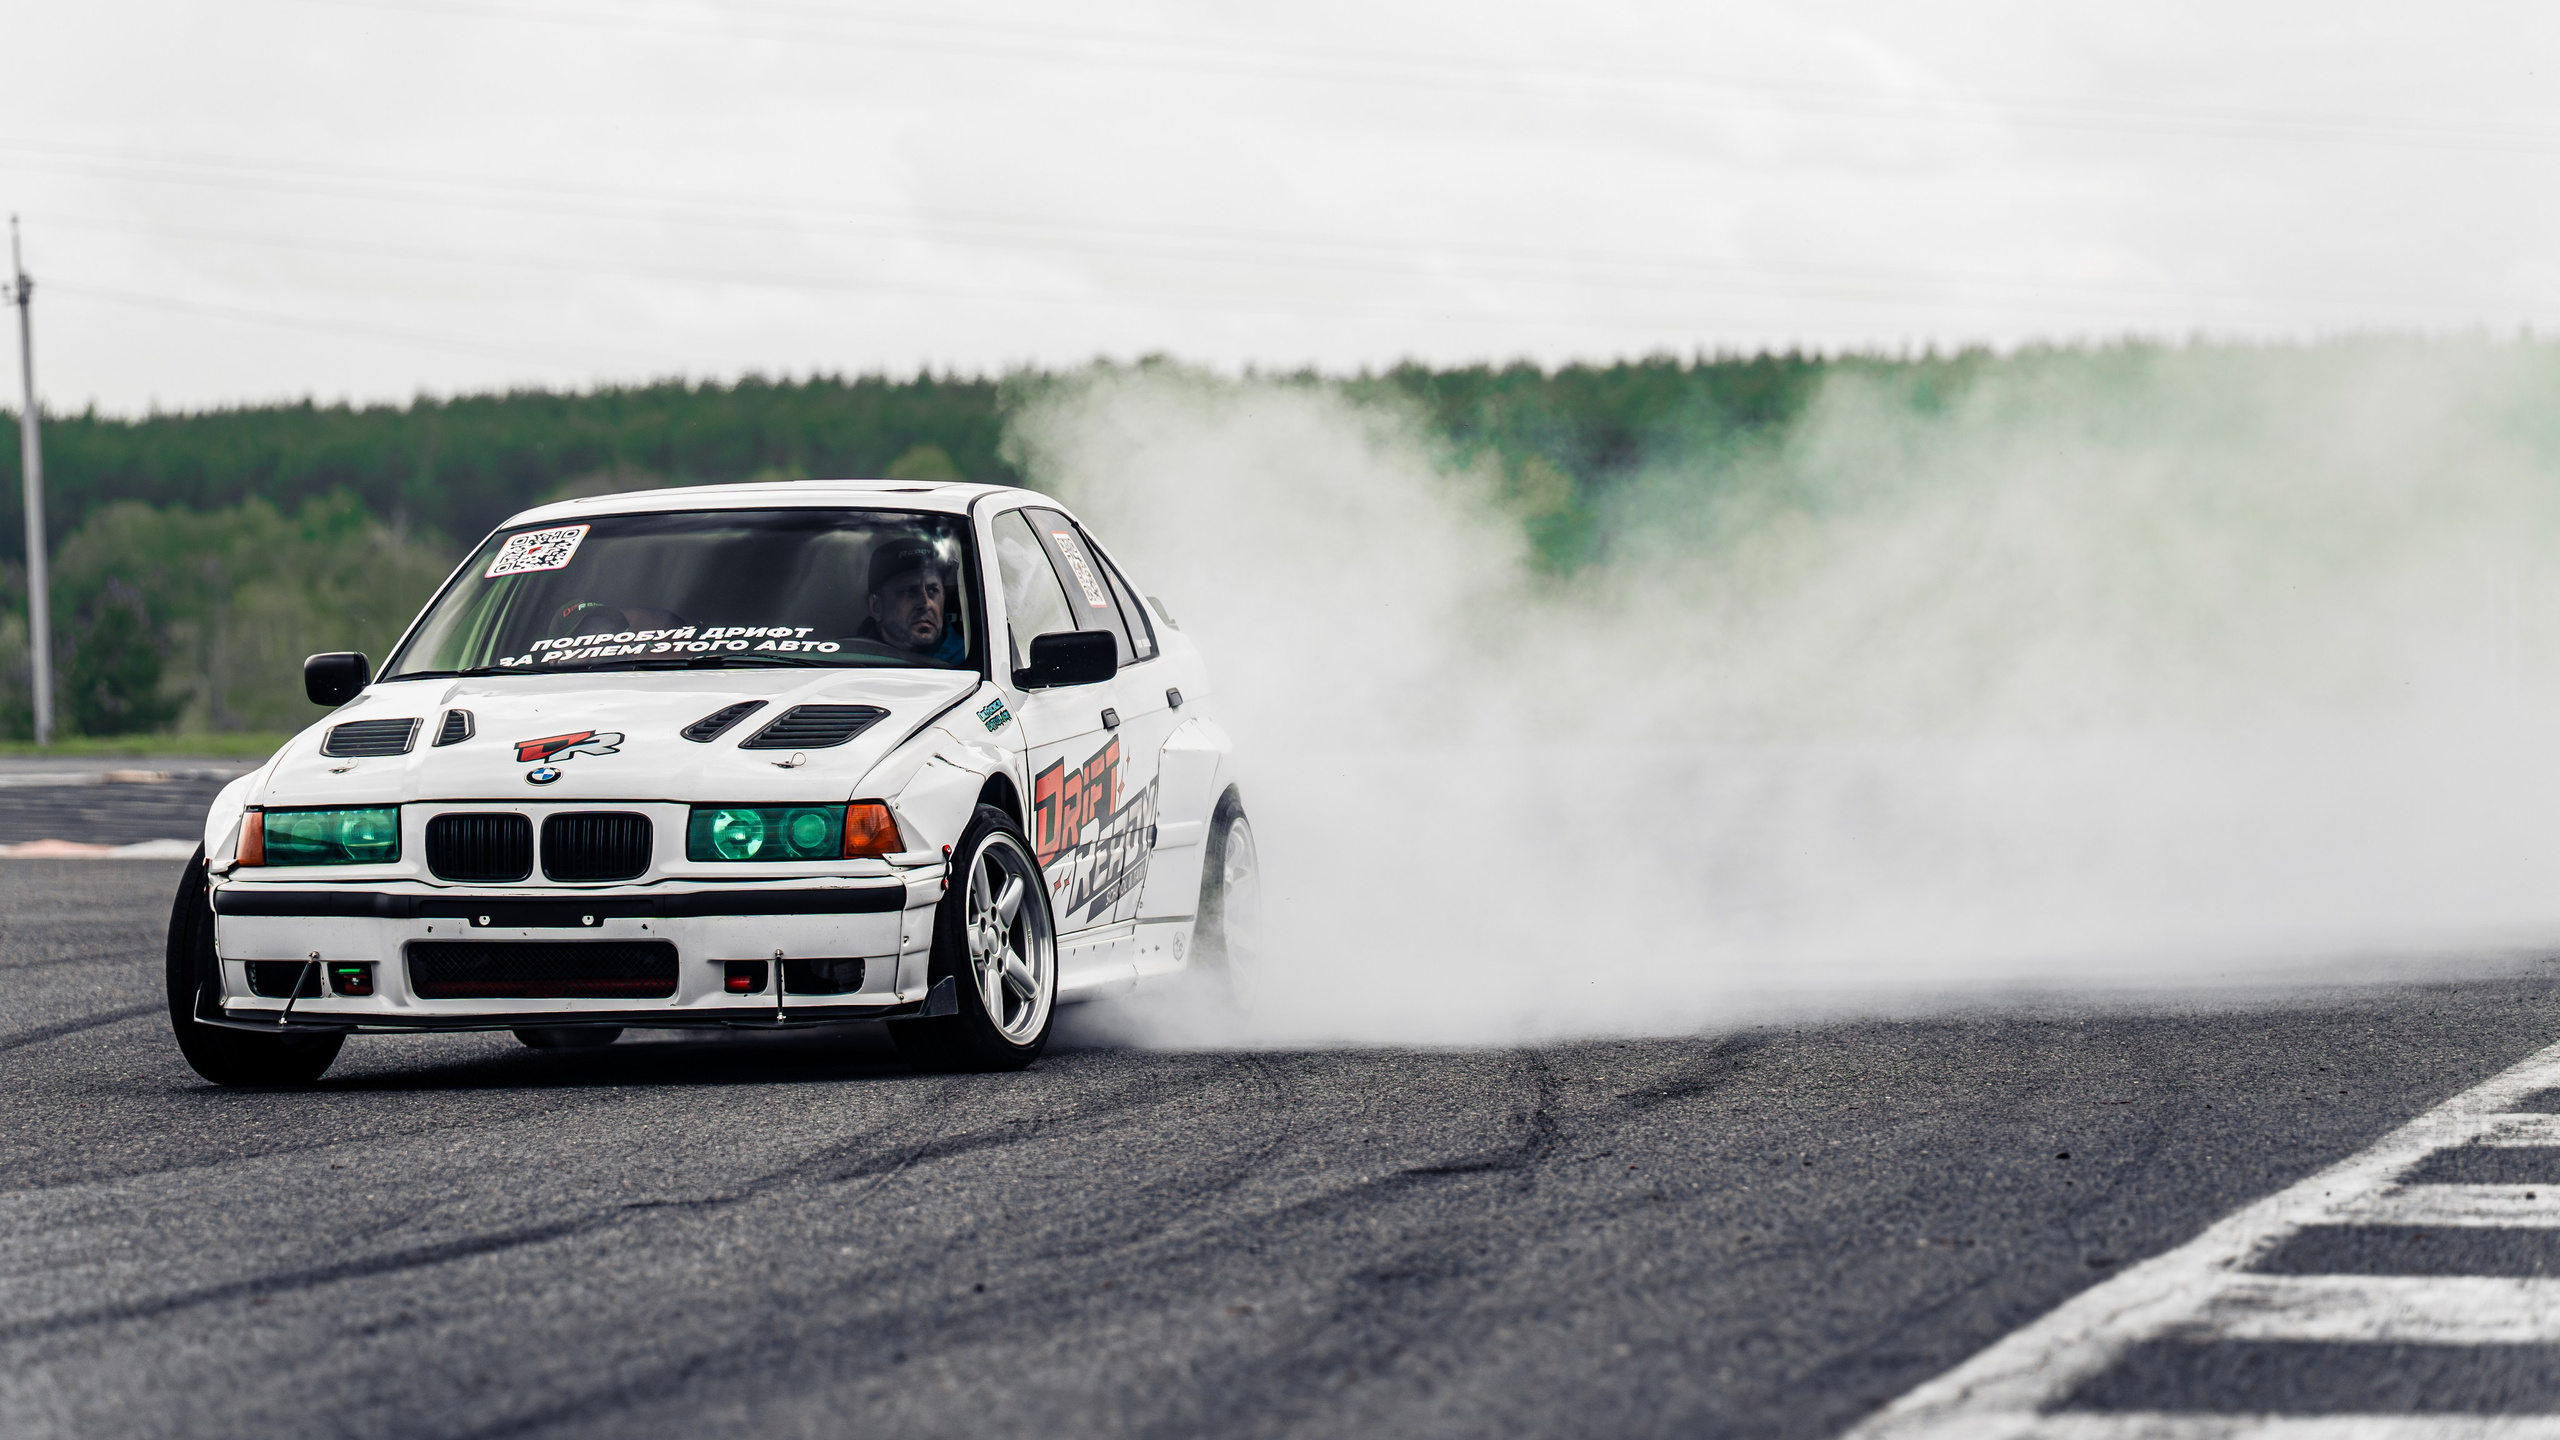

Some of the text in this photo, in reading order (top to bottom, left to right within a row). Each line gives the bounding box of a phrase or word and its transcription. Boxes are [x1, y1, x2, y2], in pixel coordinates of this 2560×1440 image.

[529, 626, 814, 652] ПОПРОБУЙ ДРИФТ
[499, 640, 841, 667] ЗА РУЛЕМ ЭТОГО АВТО
[1068, 780, 1157, 912] READY
